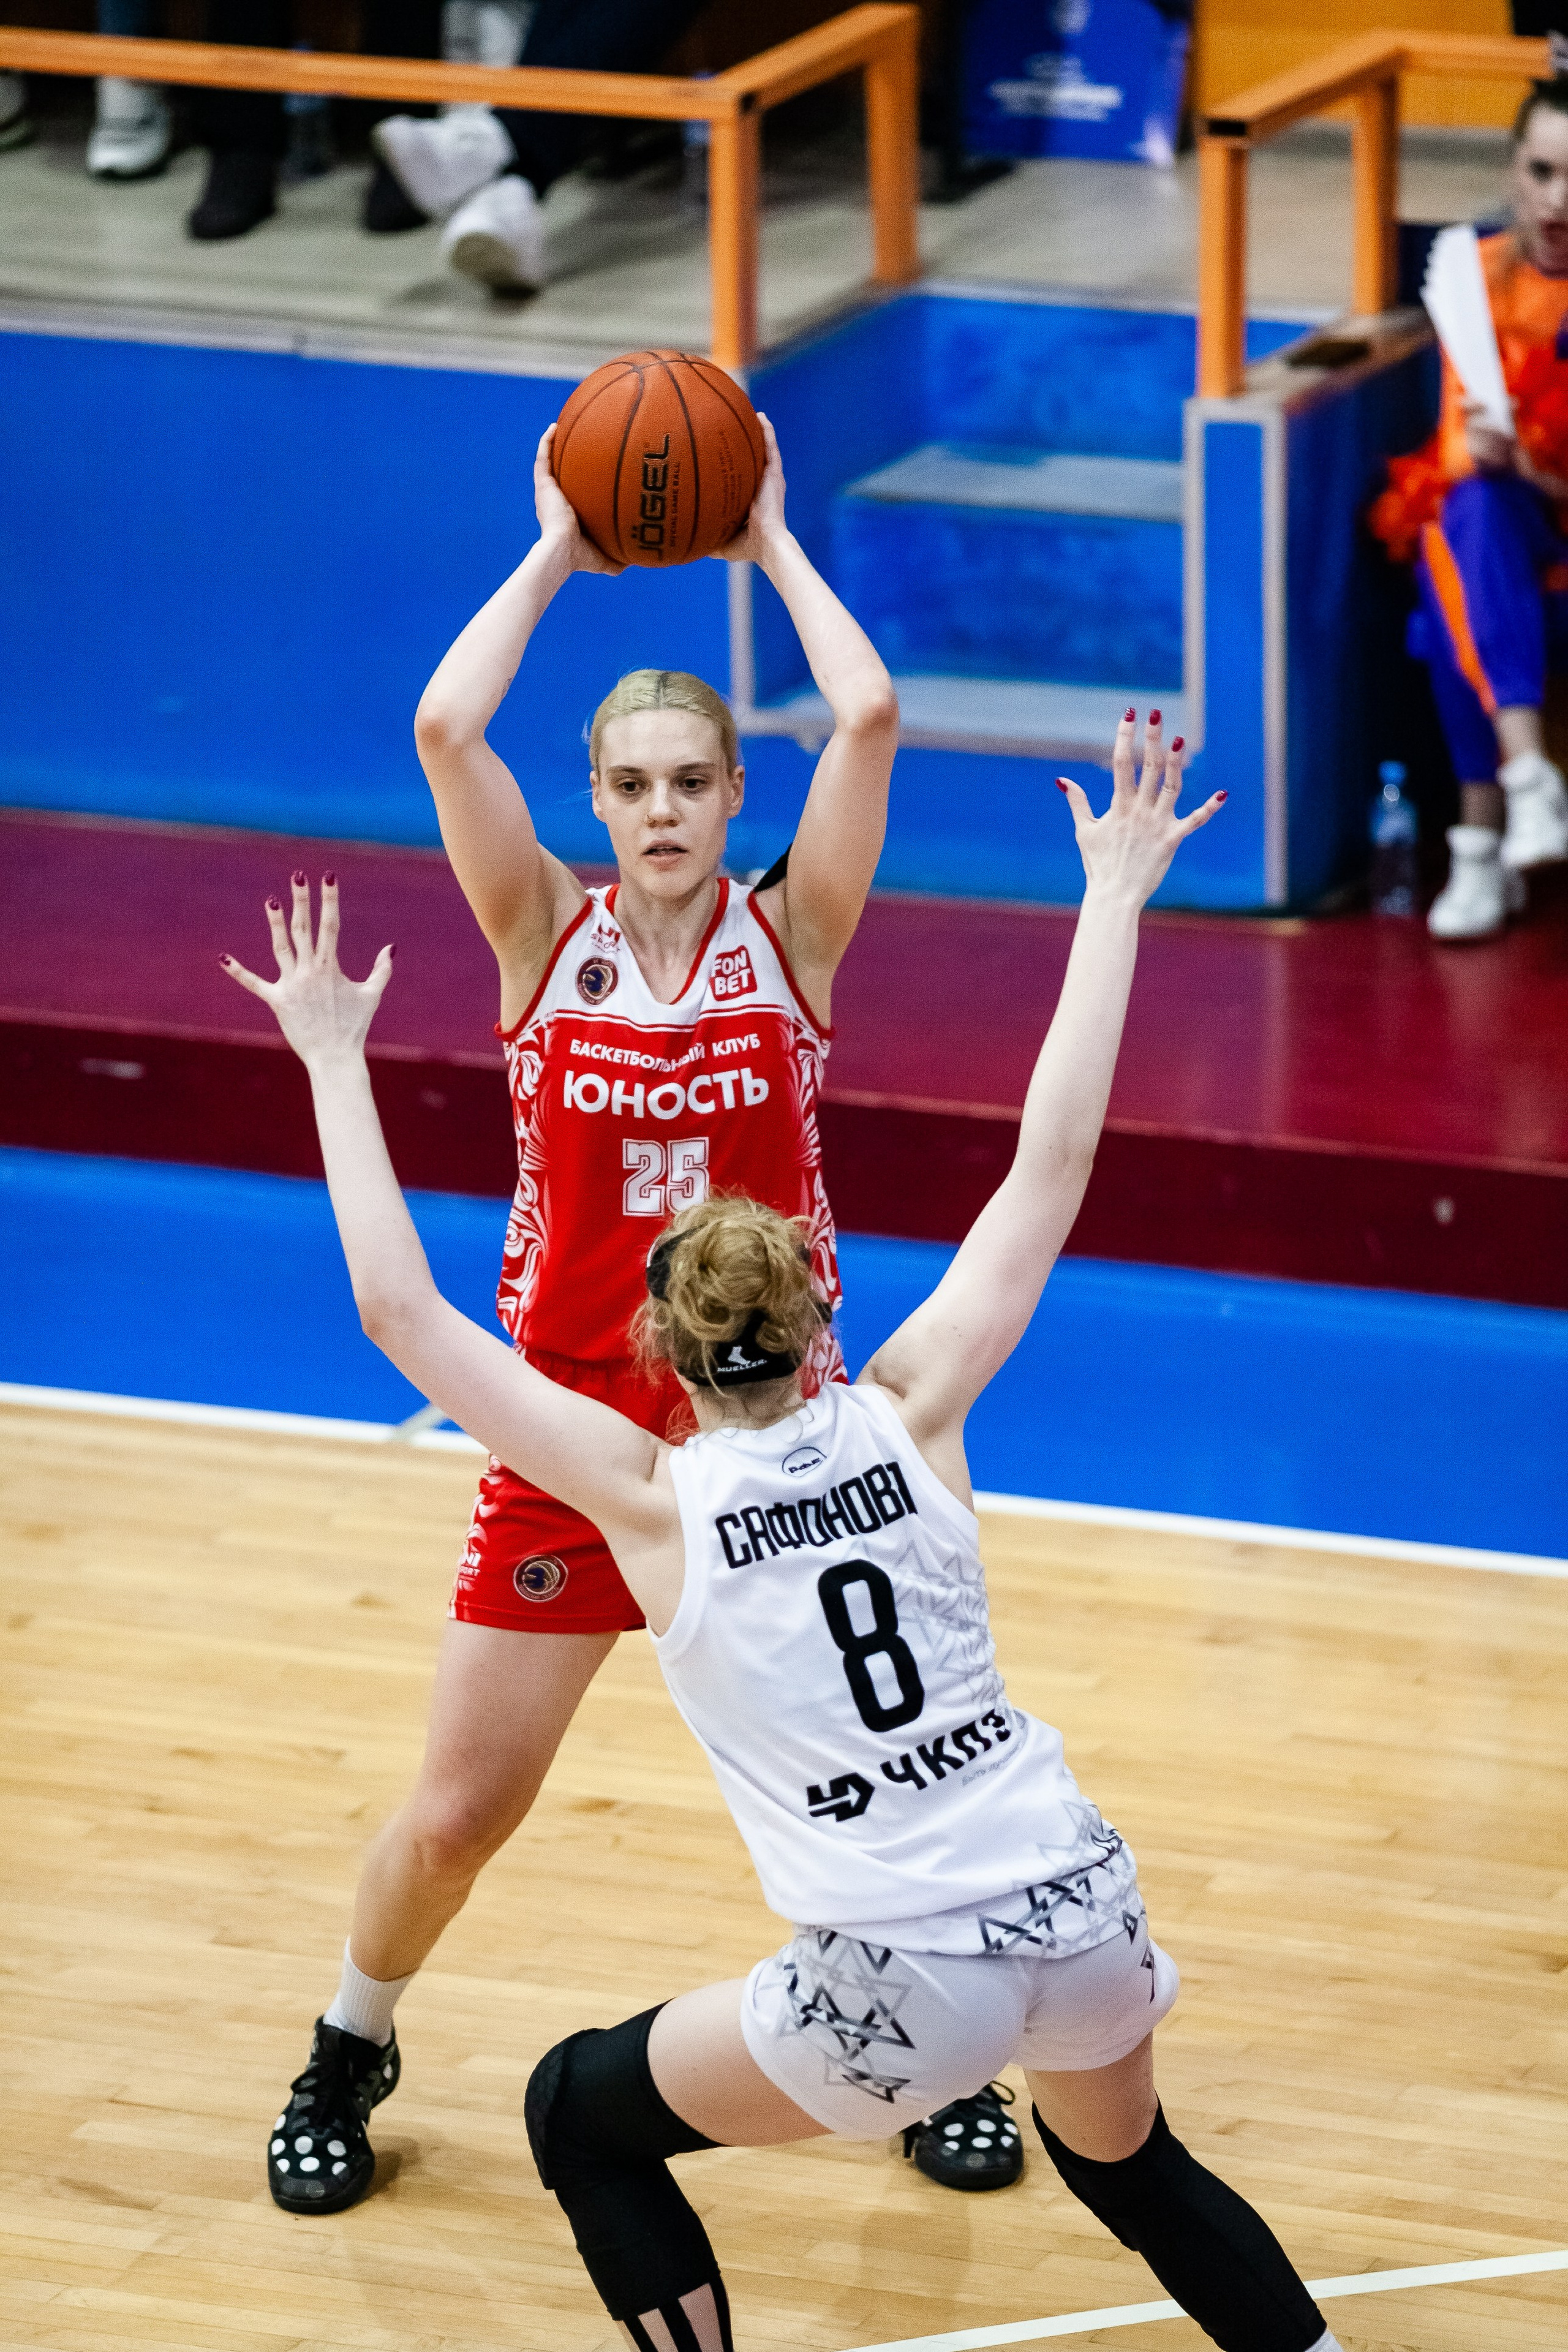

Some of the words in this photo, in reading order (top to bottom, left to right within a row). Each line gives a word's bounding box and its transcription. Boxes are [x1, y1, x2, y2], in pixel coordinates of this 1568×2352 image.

[631, 434, 670, 560] JÖGEL
[710, 950, 747, 978] FON
[714, 968, 751, 995] BET
[570, 1038, 705, 1073] БАСКЕТБОЛЬНЫЙ
[712, 1033, 761, 1057] КЛУБ
[563, 1067, 770, 1120] ЮНОСТЬ
[622, 1137, 709, 1216] 25
[717, 1359, 766, 1373] MUELLER
[817, 1558, 925, 1733] 8
